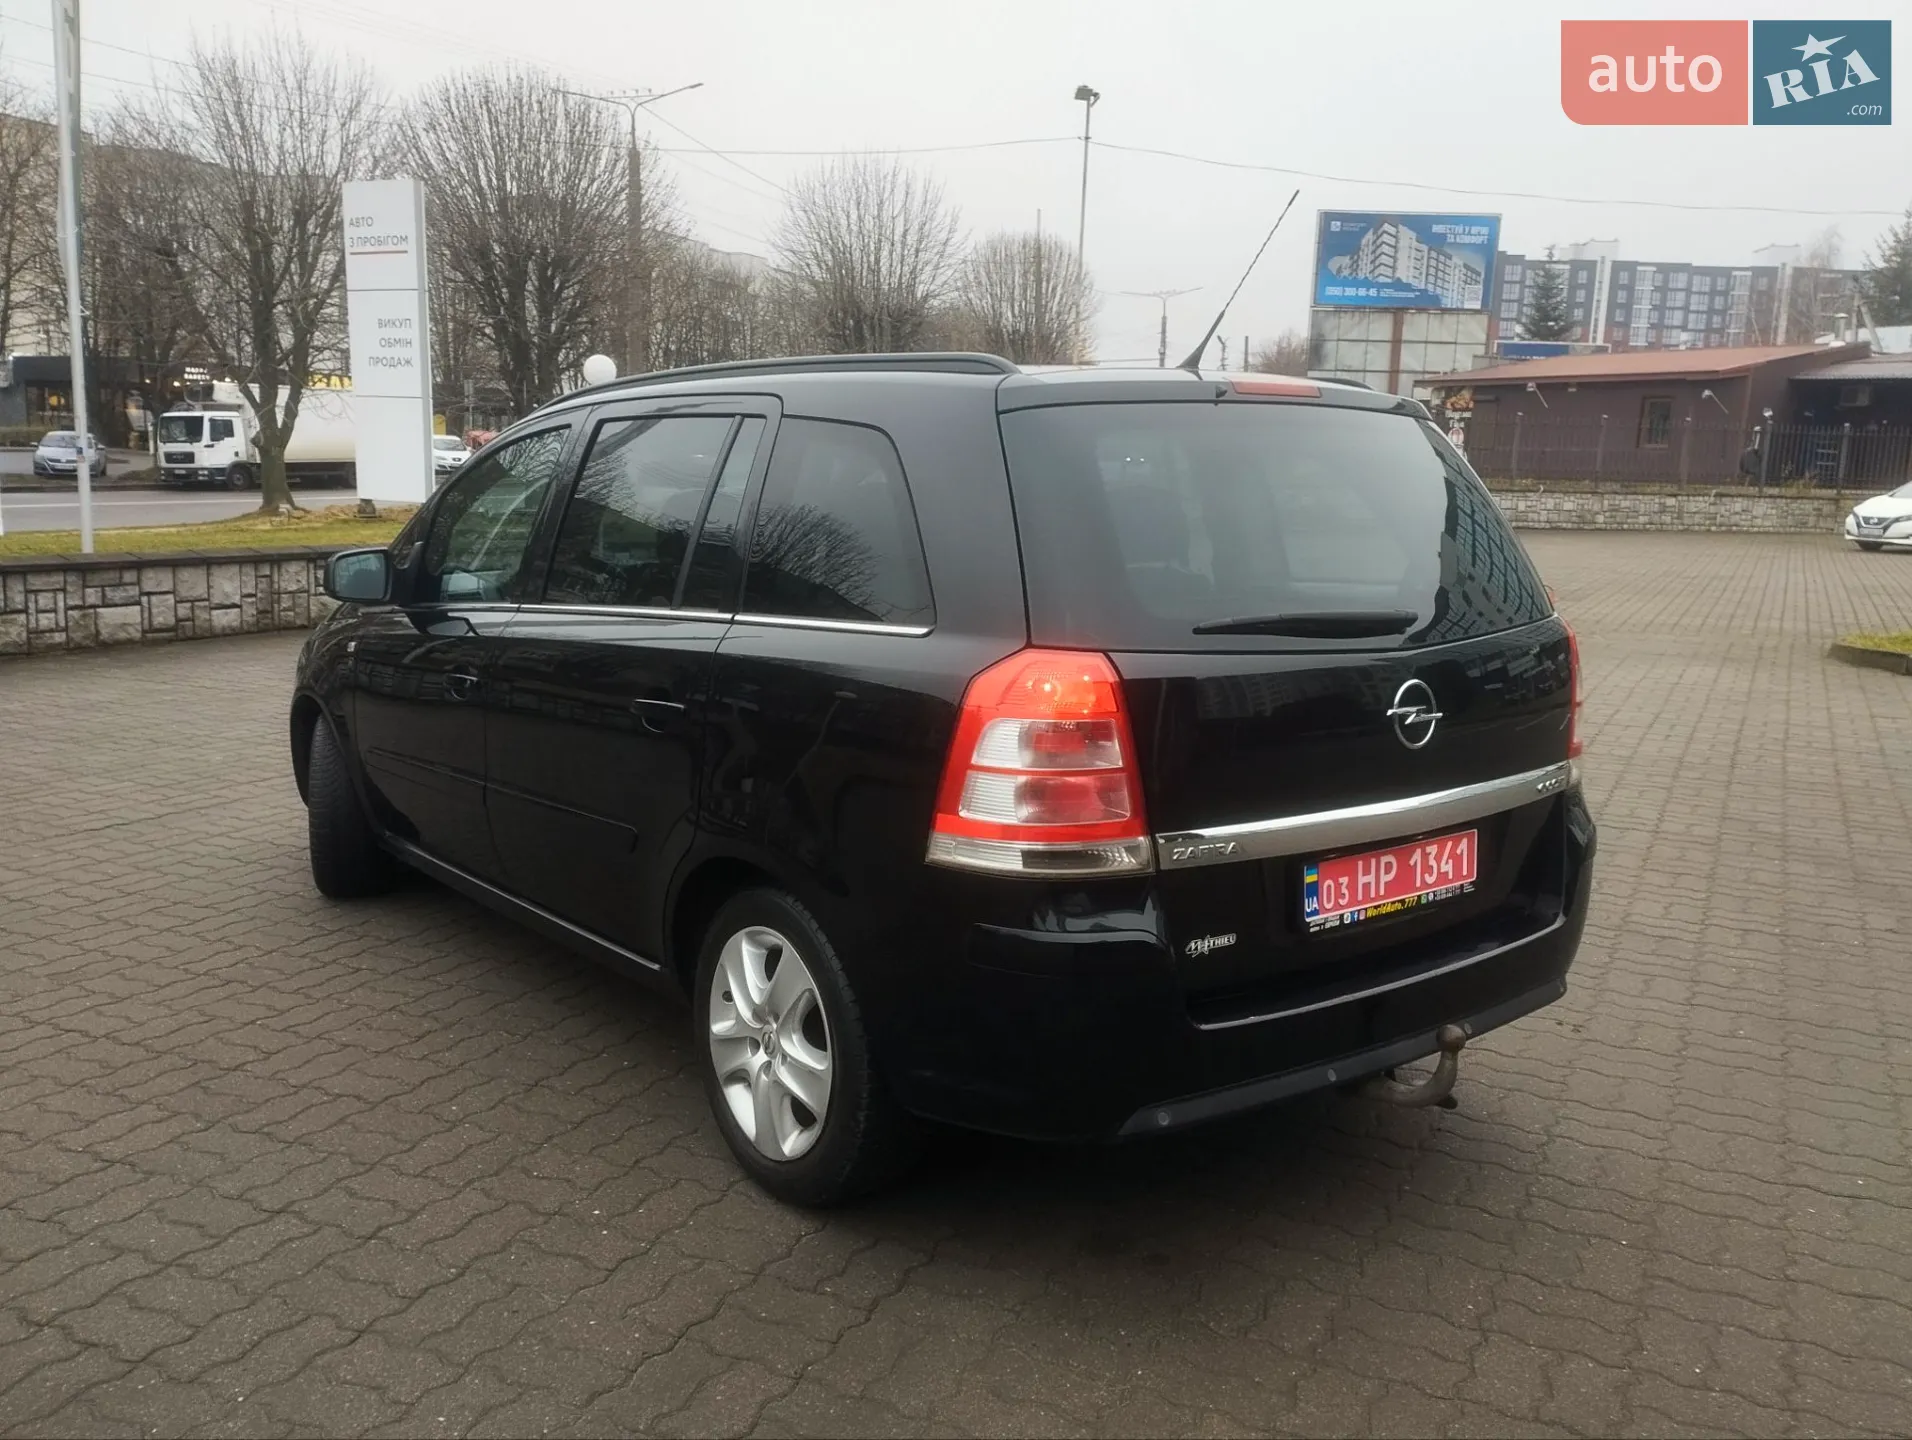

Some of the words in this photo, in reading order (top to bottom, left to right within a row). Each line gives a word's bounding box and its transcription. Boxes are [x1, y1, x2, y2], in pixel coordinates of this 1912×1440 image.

[349, 216, 374, 228] АВТО
[356, 235, 409, 247] ПРОБІГОМ
[377, 318, 412, 329] ВИКУП
[379, 337, 412, 348] ОБМІН
[368, 356, 413, 368] ПРОДАЖ
[1322, 876, 1349, 910] 03
[1357, 854, 1398, 901] HP
[1409, 837, 1468, 888] 1341
[1305, 896, 1319, 912] UA
